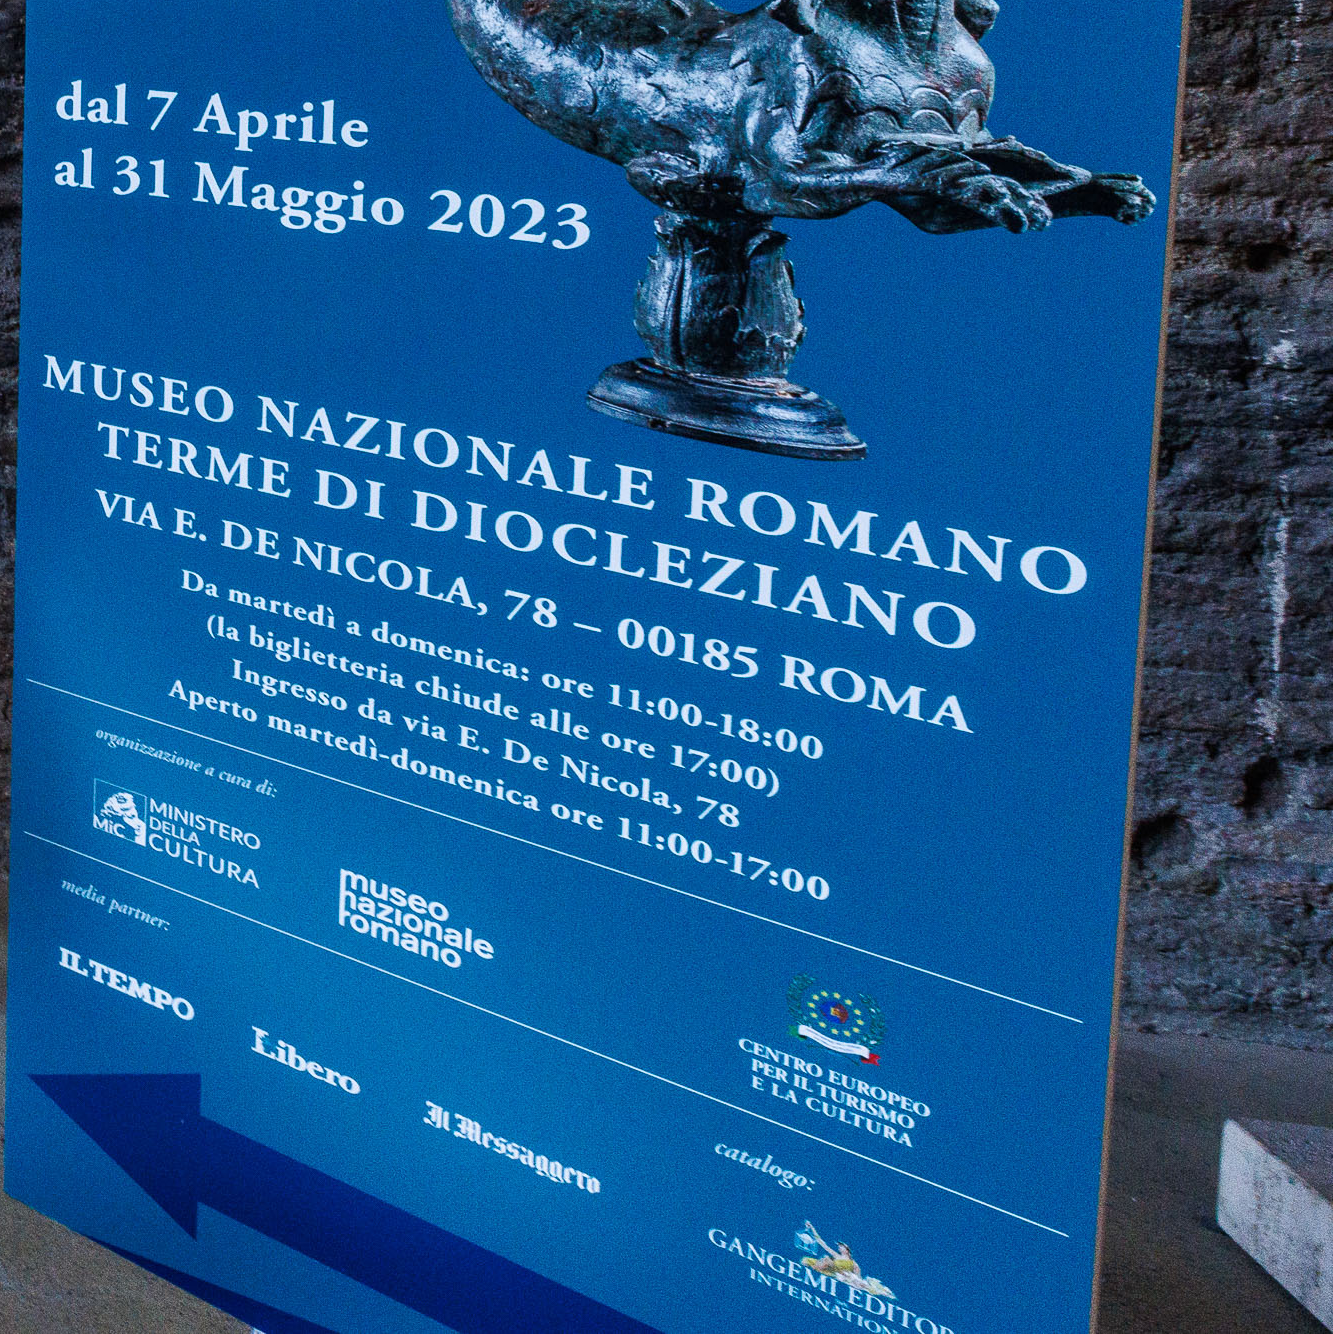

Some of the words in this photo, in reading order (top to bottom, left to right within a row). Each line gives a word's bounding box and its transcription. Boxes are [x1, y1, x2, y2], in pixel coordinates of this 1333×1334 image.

[55, 79, 129, 125] dal
[145, 89, 178, 131] 7
[192, 92, 369, 152] Aprile
[54, 147, 95, 189] al
[112, 154, 171, 198] 31
[192, 161, 405, 233] Maggio
[427, 188, 592, 250] 2023
[42, 354, 234, 423] MUSEO
[256, 395, 656, 511] NAZIONALE
[684, 477, 1088, 595] ROMANO
[97, 421, 292, 498] TERME
[314, 468, 385, 520] DI
[411, 490, 976, 649] DIOCLEZIANO
[95, 488, 163, 531] VIA
[172, 508, 208, 542] E.
[220, 520, 281, 561] DE
[293, 536, 488, 617] NICOLA,
[503, 589, 559, 629] 78
[617, 618, 759, 679] 00185
[779, 654, 974, 734] ROMA
[181, 569, 220, 599] Da
[228, 585, 337, 631] martedì
[346, 618, 362, 638] a
[370, 622, 531, 683] domenica:
[541, 673, 595, 700] ore
[609, 683, 824, 760] 11:00-18:00
[206, 614, 240, 642] (la
[249, 626, 404, 690] biglietteria
[414, 674, 520, 722] chiude
[529, 705, 591, 743] alle
[600, 730, 657, 761] ore
[669, 748, 781, 798] 17:00)
[95, 728, 202, 772] organizzazione
[204, 766, 215, 777] a
[218, 771, 251, 789] cura
[255, 779, 277, 798] di:
[231, 659, 348, 715] Ingresso
[357, 697, 394, 730] da
[403, 713, 447, 743] via
[459, 726, 491, 755] E.
[502, 739, 550, 773] De
[561, 758, 683, 817] Nicola,
[696, 795, 741, 829] 78
[93, 814, 126, 839] MiC
[149, 797, 261, 850] MINISTERO
[168, 679, 258, 726] Aperto
[267, 713, 540, 813] martedì-domenica
[550, 802, 604, 832] ore
[616, 816, 831, 902] 11:00-17:00
[148, 833, 260, 890] CULTURA
[149, 817, 201, 846] DELLA
[61, 877, 105, 906] media
[108, 897, 171, 931] partner:
[339, 867, 449, 922] museo
[339, 891, 495, 961] nazionale
[339, 912, 462, 969] romano
[58, 946, 90, 977] IL
[88, 962, 196, 1022] TEMPO
[251, 1025, 361, 1095] Libero
[738, 1038, 823, 1078] CENTRO
[829, 1069, 931, 1117] EUROPEO
[751, 1058, 788, 1084] PER
[793, 1074, 813, 1093] IL
[817, 1082, 915, 1129] TURISMO
[423, 1100, 451, 1132] Il
[453, 1112, 601, 1194] Messaggero
[751, 1075, 764, 1091] E
[771, 1082, 798, 1105] LA
[805, 1096, 913, 1148] CULTURA
[714, 1142, 816, 1191] catalogo:
[708, 1228, 838, 1297] GANGEMI
